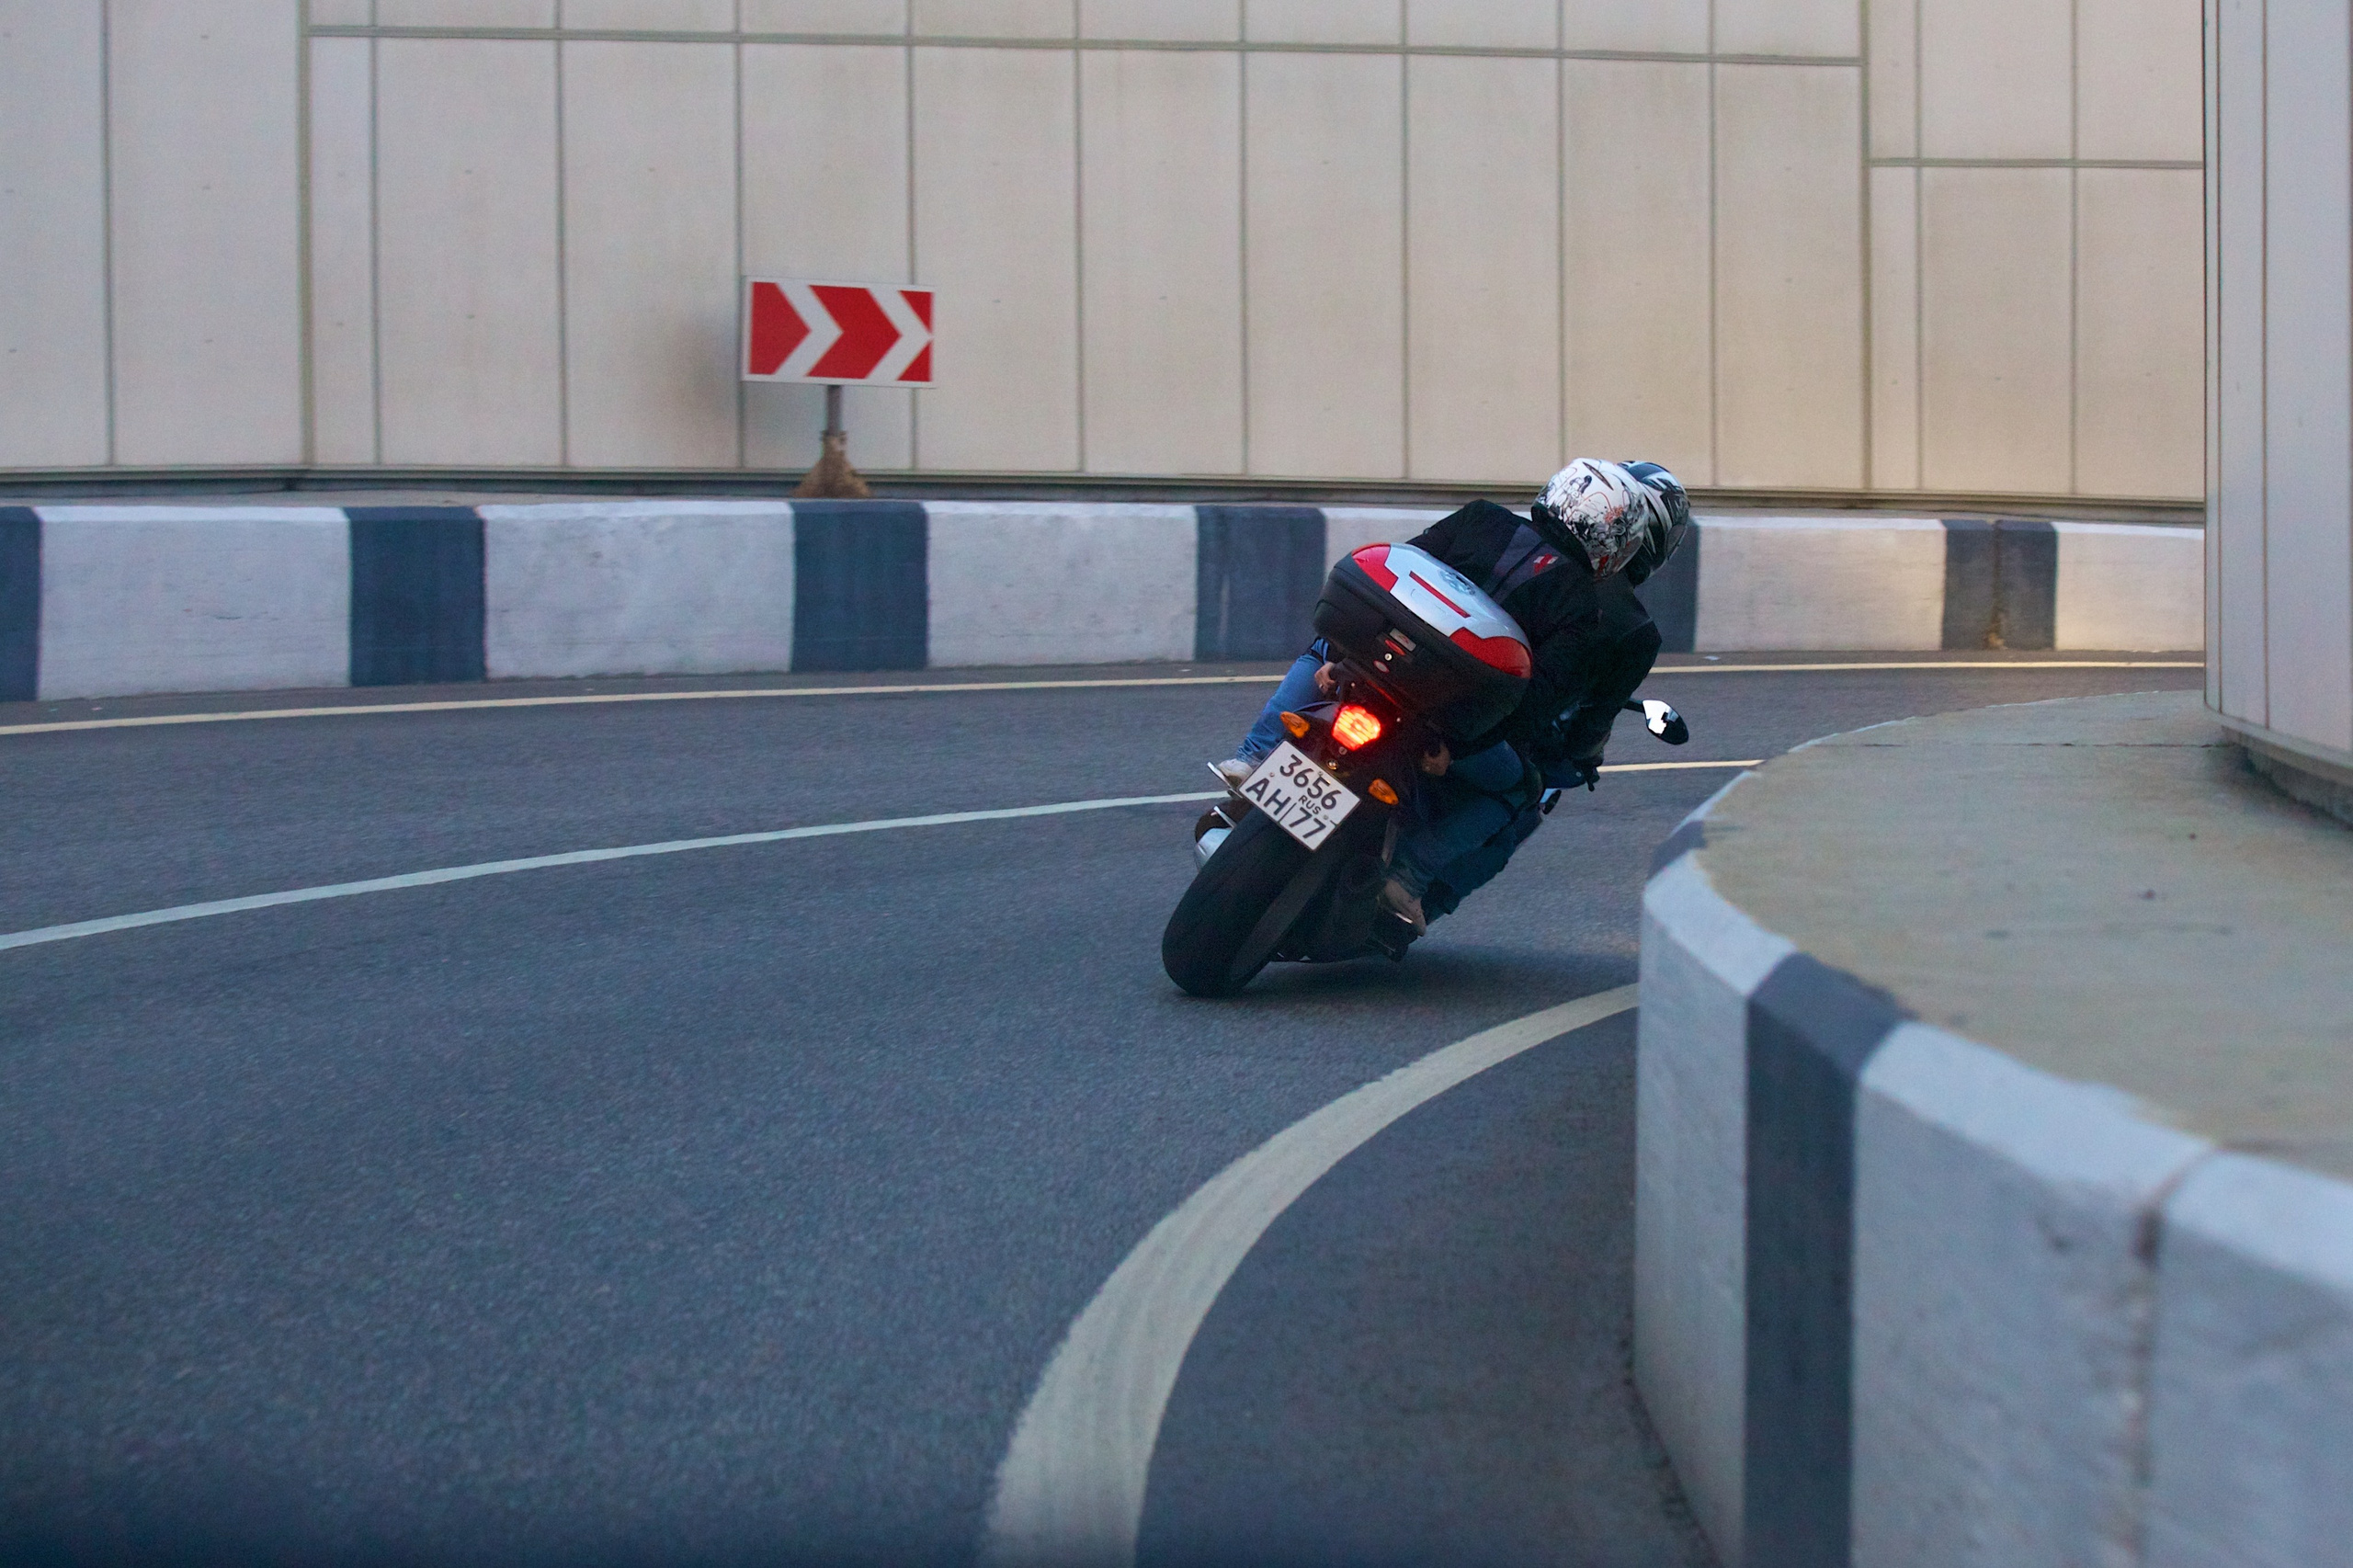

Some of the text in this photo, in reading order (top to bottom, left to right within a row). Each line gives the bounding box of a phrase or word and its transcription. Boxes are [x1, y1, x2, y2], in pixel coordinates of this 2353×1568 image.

[1245, 778, 1291, 815] AH
[1279, 754, 1341, 810] 3656
[1298, 795, 1321, 814] RUS
[1289, 807, 1326, 839] 77
